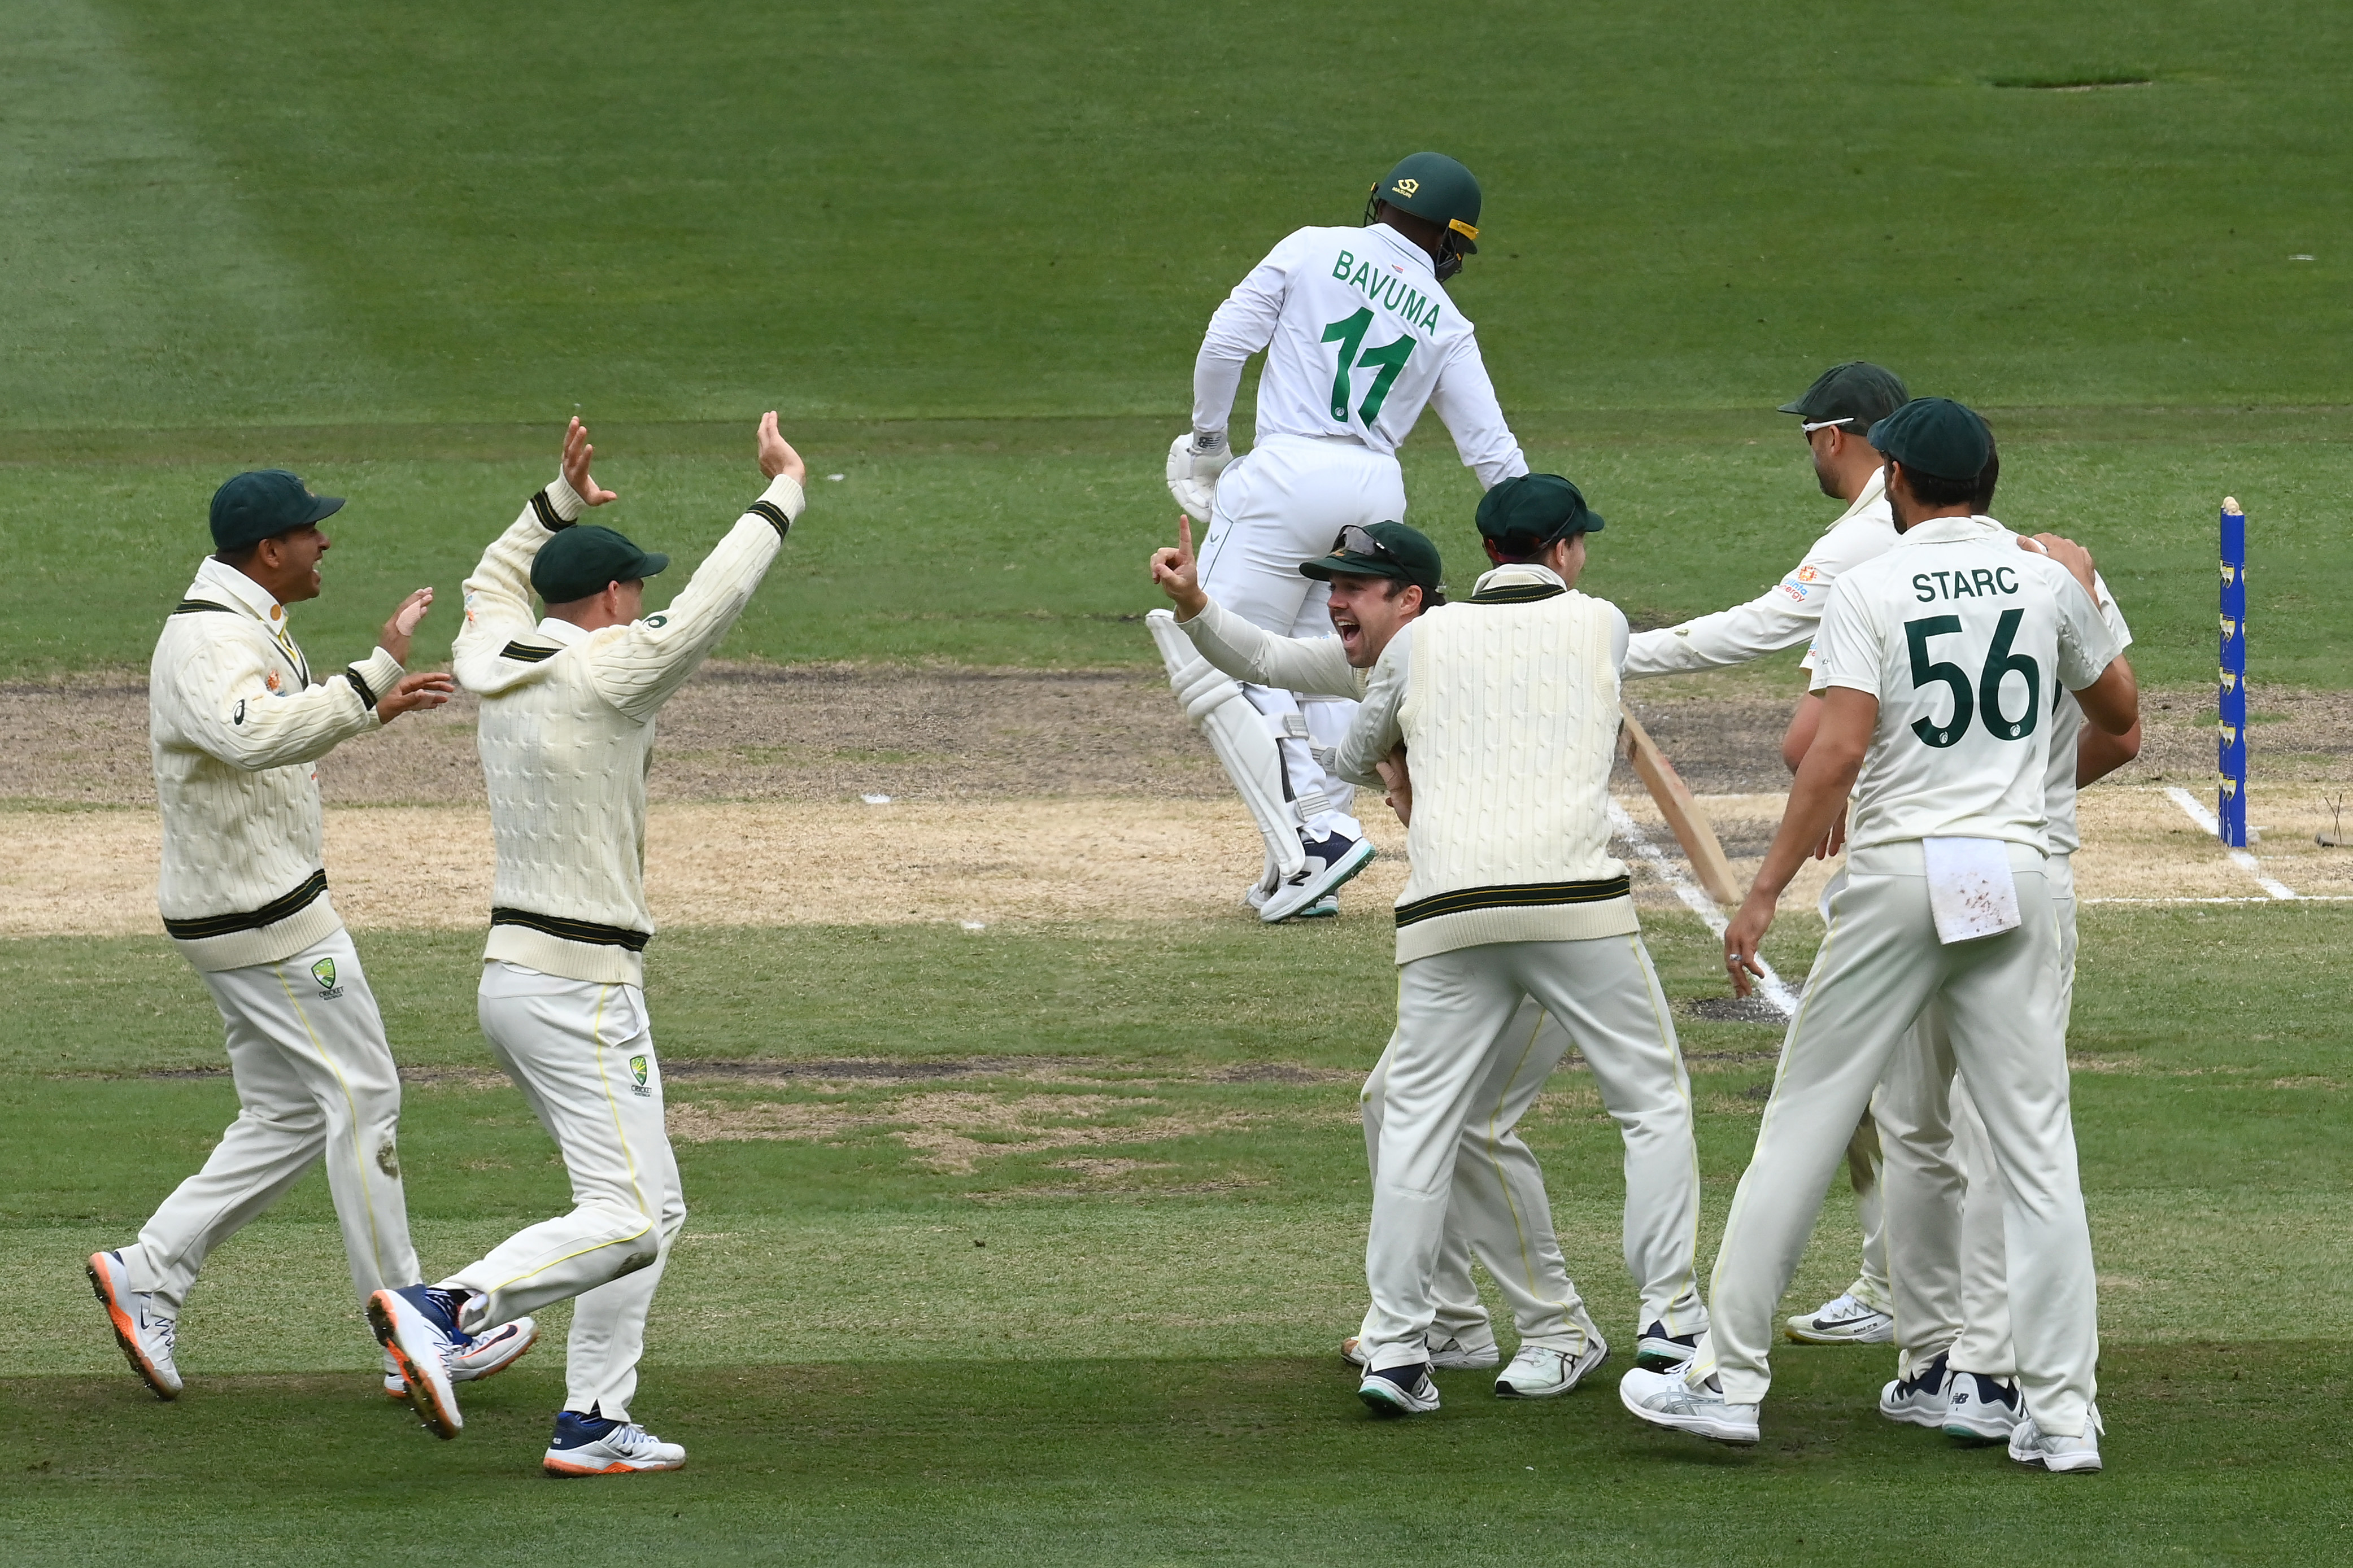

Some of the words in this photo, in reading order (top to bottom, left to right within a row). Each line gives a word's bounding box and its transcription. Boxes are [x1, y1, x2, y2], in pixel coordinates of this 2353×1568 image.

[1332, 250, 1440, 336] BAVUMA
[1321, 306, 1417, 429] 11
[1912, 567, 2019, 602] STARC
[1903, 608, 2040, 748] 56
